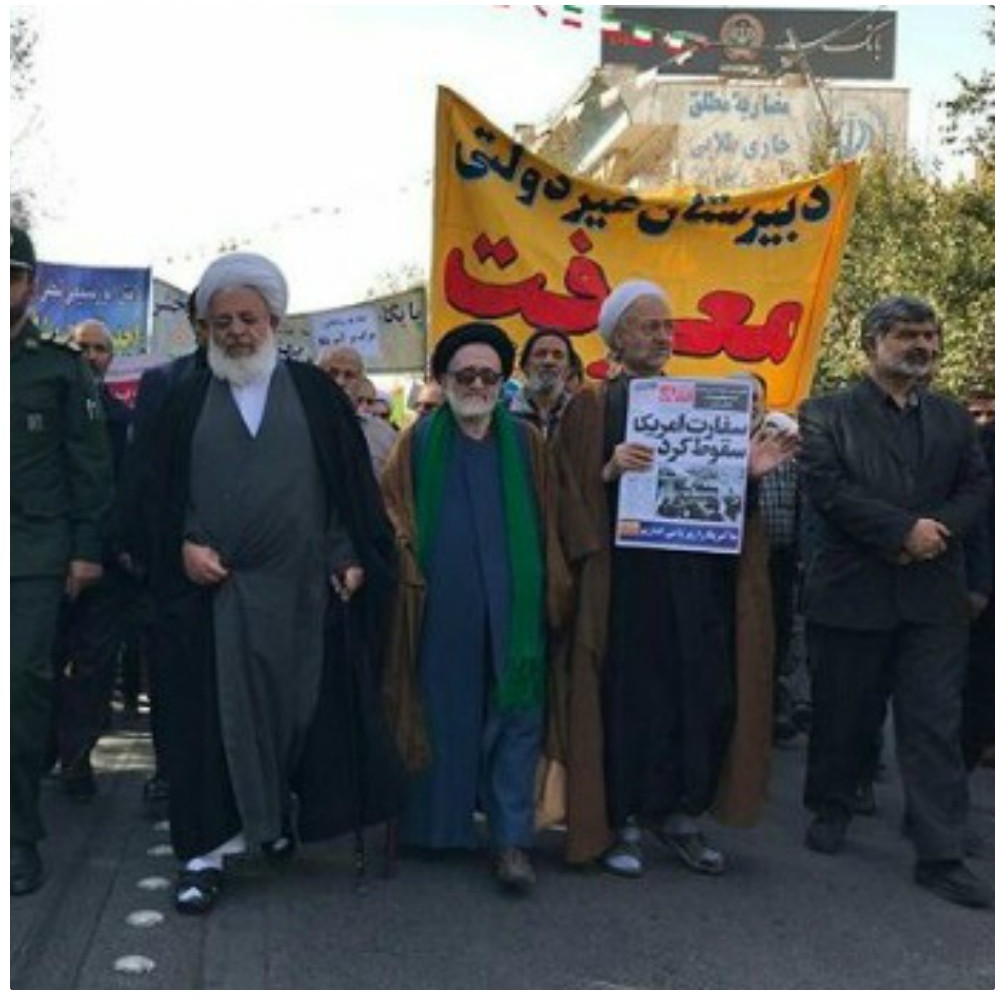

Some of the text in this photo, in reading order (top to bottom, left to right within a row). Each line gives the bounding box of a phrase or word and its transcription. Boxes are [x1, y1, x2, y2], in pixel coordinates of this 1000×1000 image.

[638, 184, 831, 245] دبیرستان
[443, 228, 805, 380] معفت
[633, 412, 747, 440] سفارت امریکا
[657, 437, 746, 464] سقوط کرد
